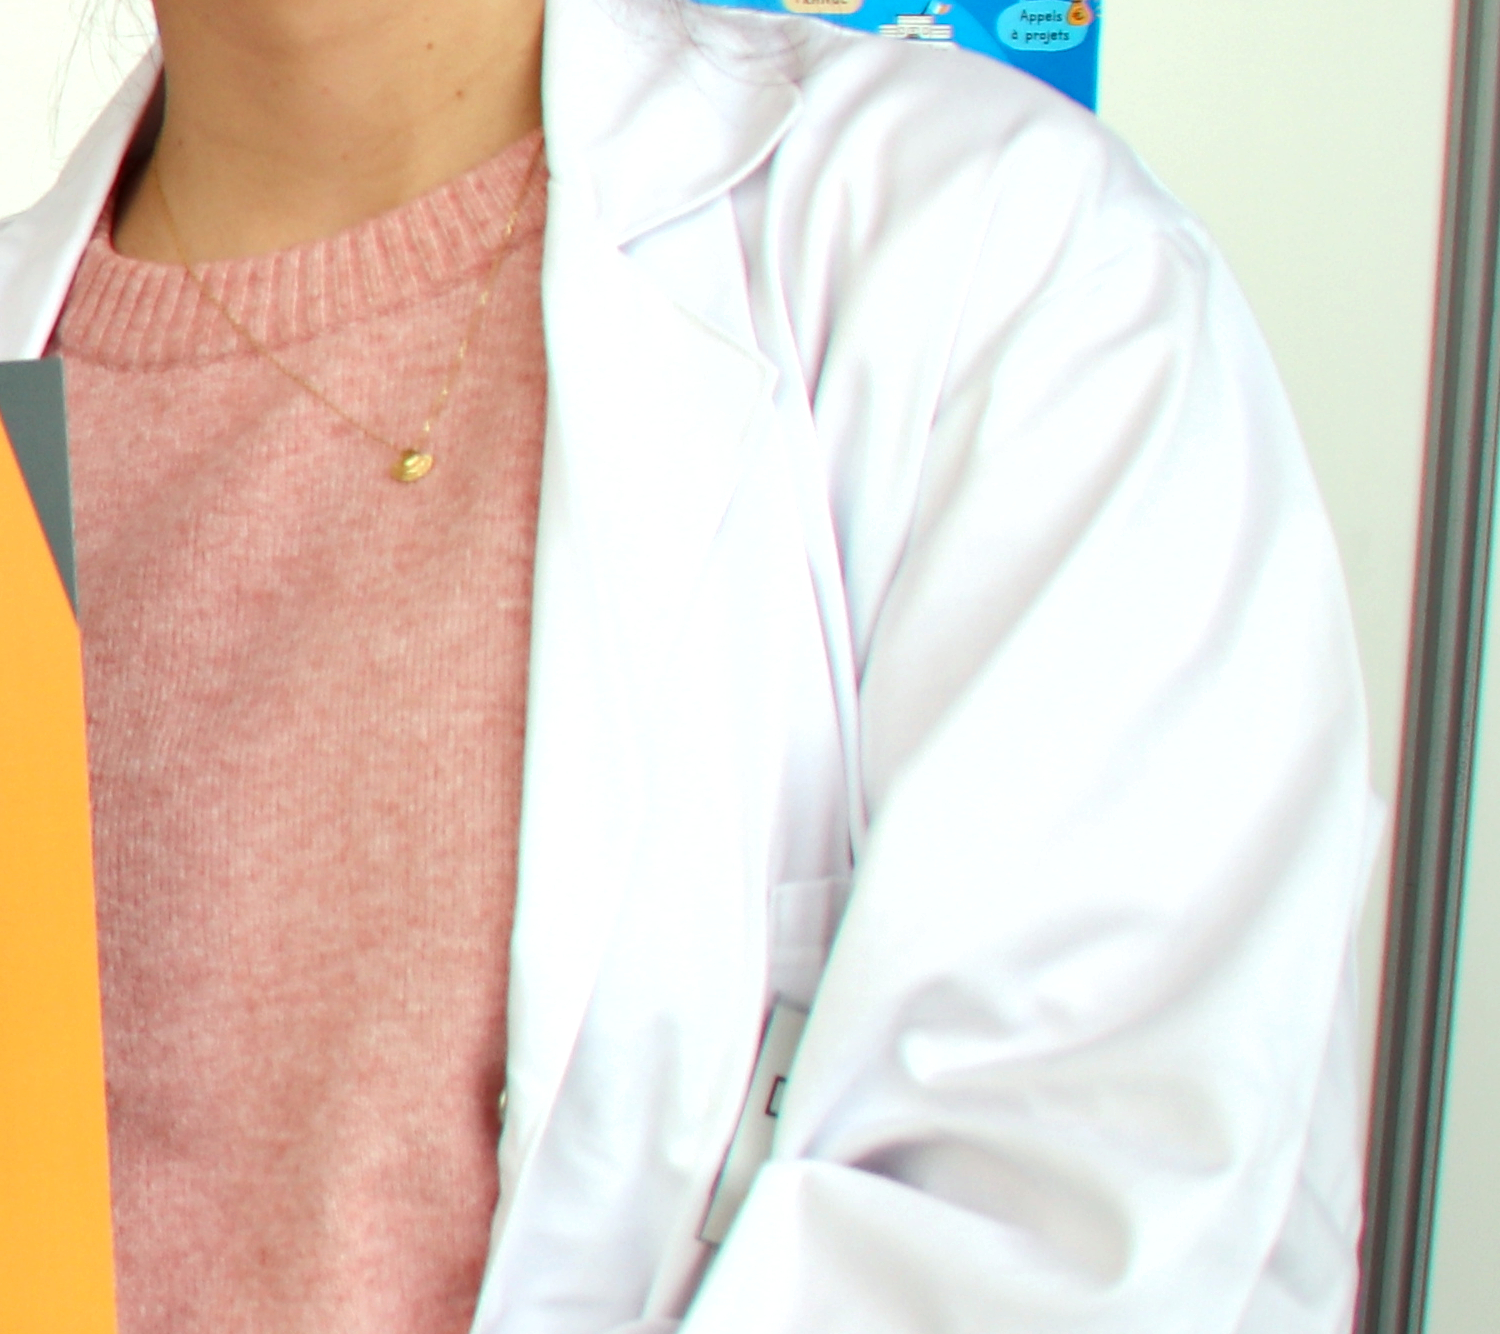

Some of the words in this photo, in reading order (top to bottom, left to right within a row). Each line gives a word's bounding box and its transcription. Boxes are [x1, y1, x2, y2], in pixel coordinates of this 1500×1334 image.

[1020, 10, 1063, 24] Appels
[1011, 30, 1018, 40] à
[1025, 29, 1070, 44] projets
